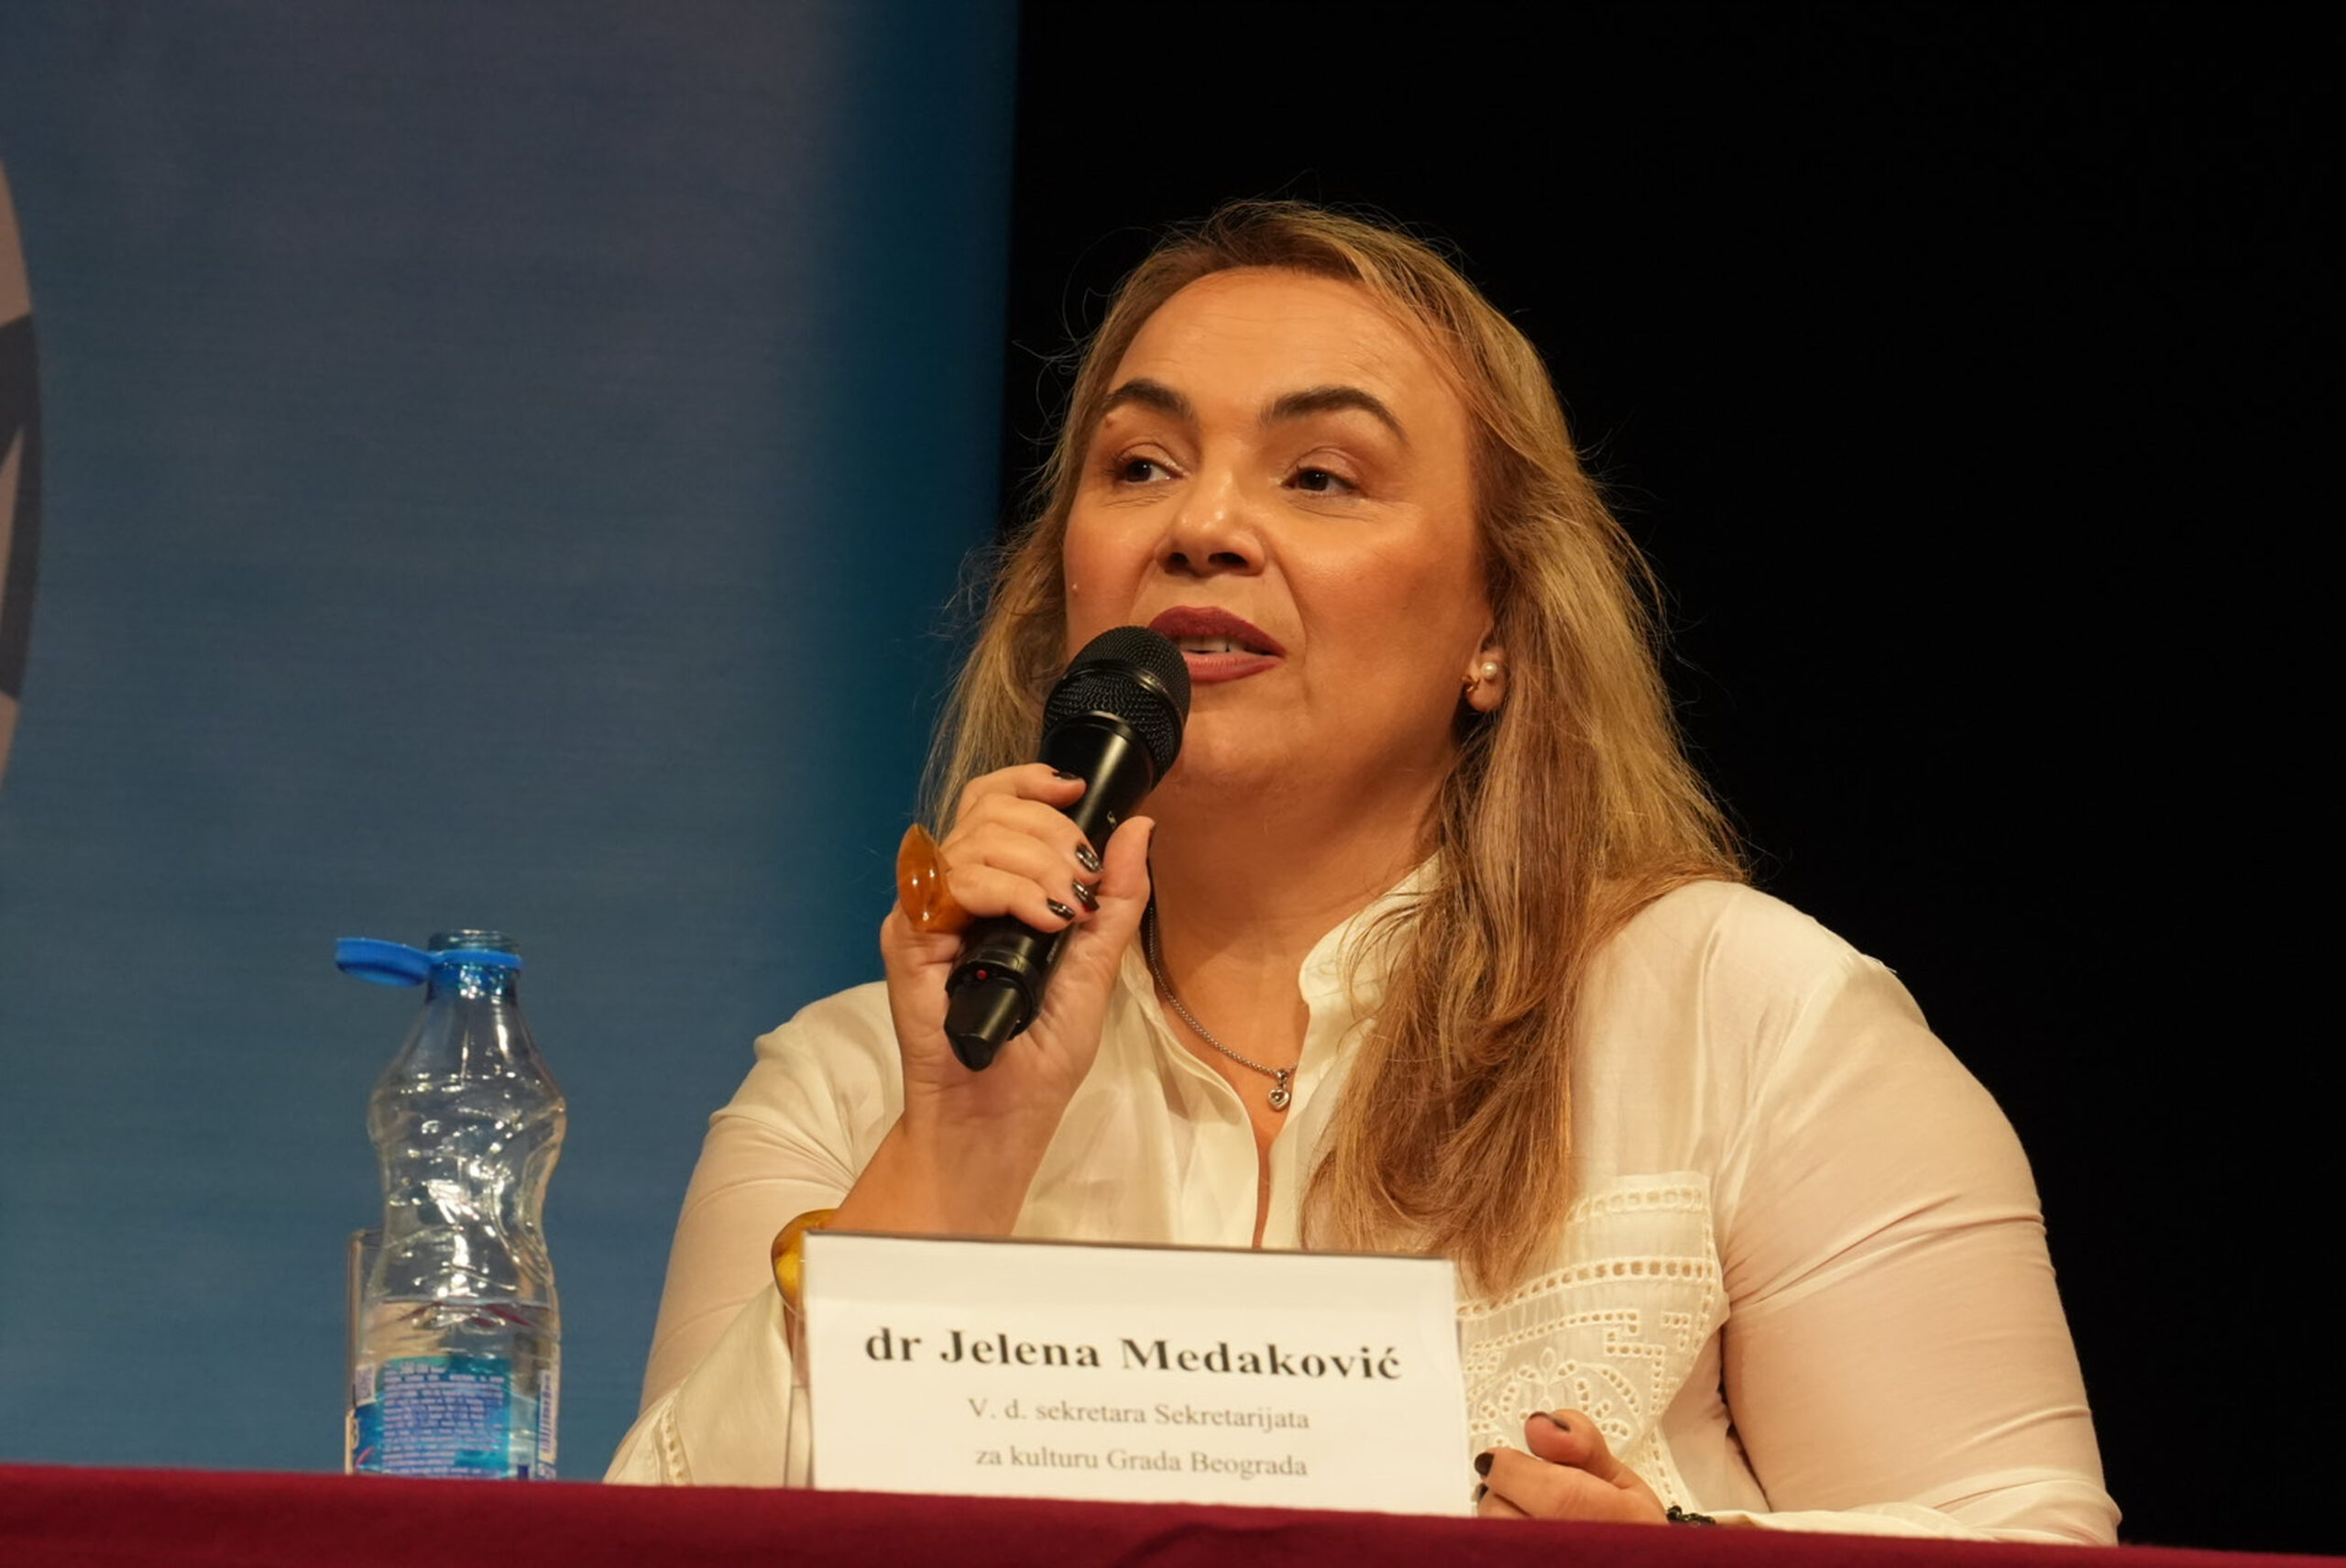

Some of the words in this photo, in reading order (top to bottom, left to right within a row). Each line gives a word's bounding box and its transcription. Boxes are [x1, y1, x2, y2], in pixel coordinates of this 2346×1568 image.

[864, 1327, 922, 1362] dr
[939, 1330, 1101, 1368] Jelena
[1118, 1337, 1401, 1380] Medaković
[967, 1398, 997, 1420] V.
[1003, 1398, 1028, 1421] d.
[1036, 1399, 1146, 1424] sekretara
[1154, 1404, 1310, 1433] Sekretarijata
[975, 1450, 1003, 1467] za
[1009, 1444, 1099, 1470] kulturu
[1105, 1449, 1183, 1472] Grada
[1189, 1451, 1310, 1481] Beograda
